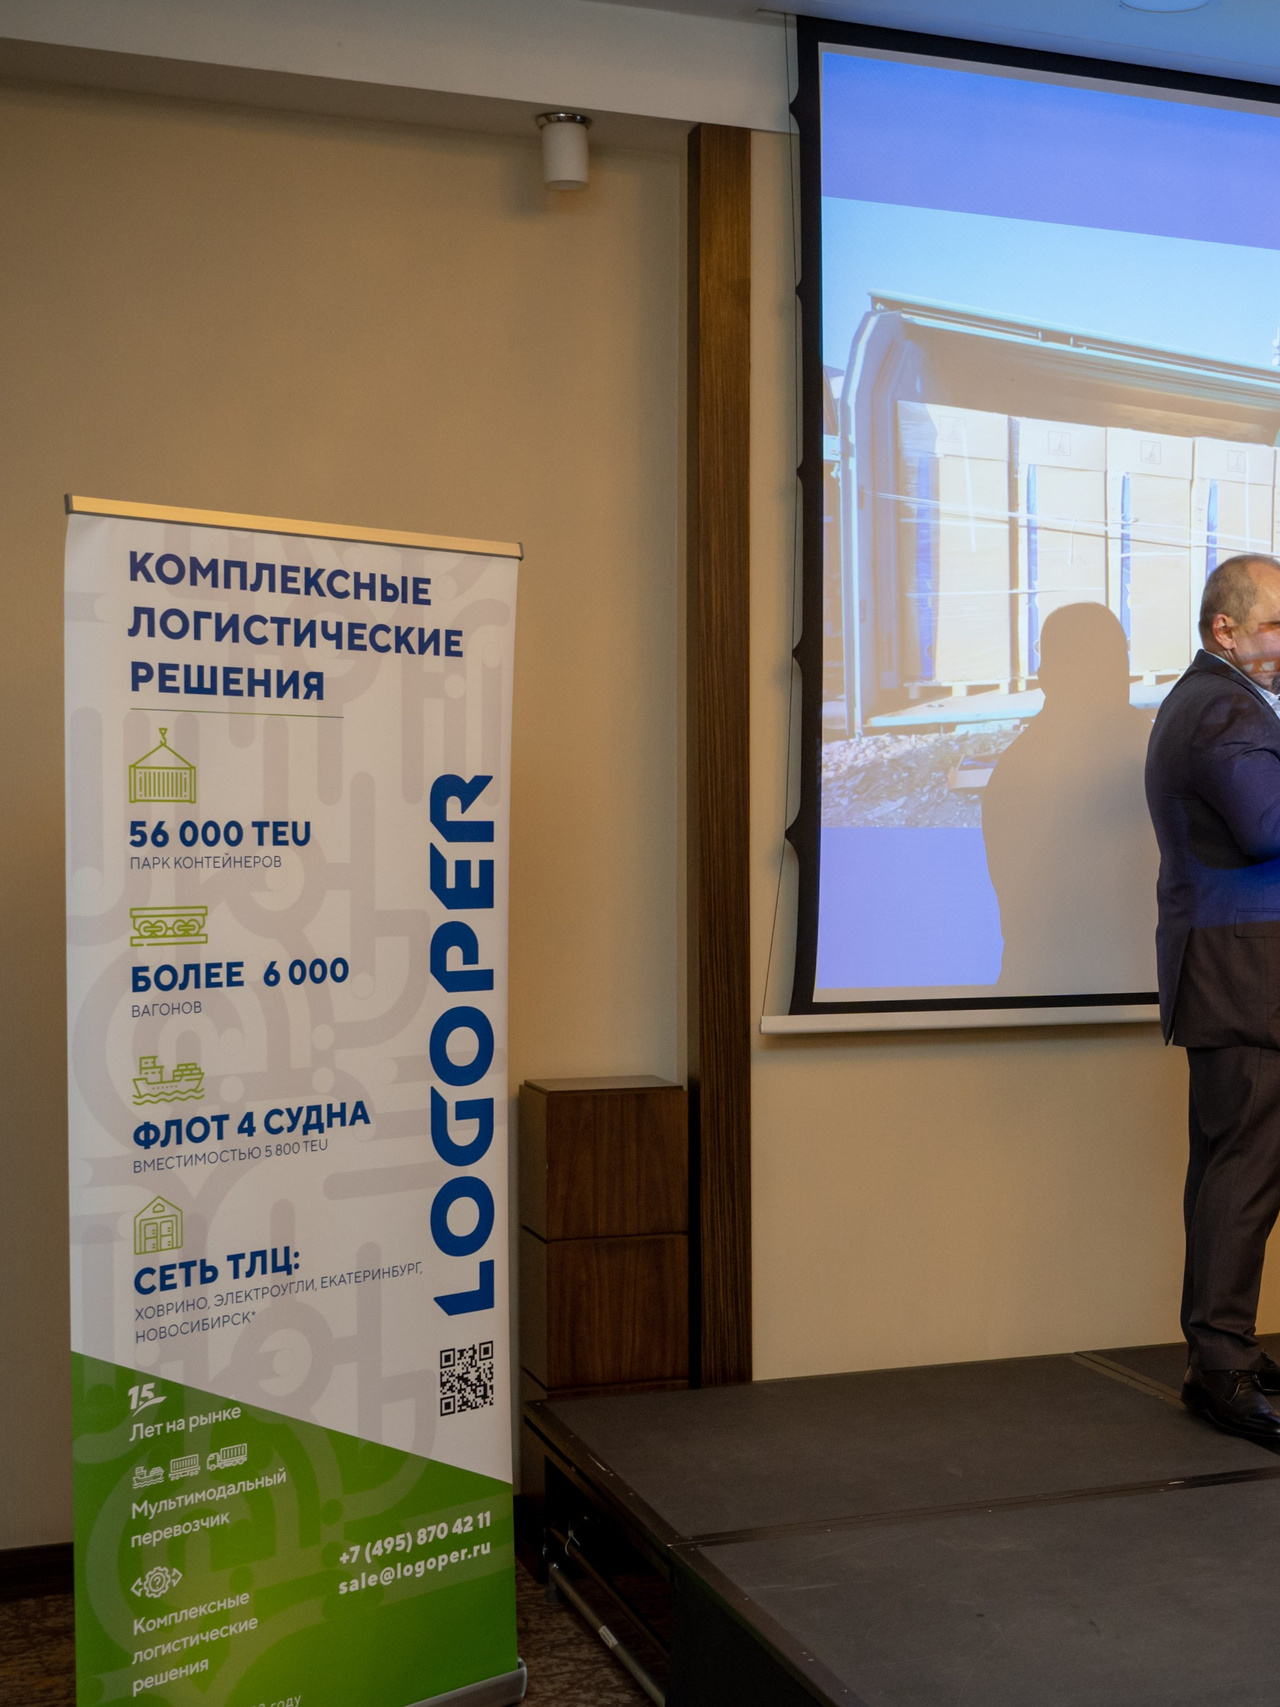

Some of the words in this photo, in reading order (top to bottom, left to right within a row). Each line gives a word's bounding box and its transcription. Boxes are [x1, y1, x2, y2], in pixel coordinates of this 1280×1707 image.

[129, 550, 432, 606] КОМПЛЕКСНЫЕ
[127, 606, 463, 658] ЛОГИСТИЧЕСКИЕ
[130, 661, 324, 700] РЕШЕНИЯ
[129, 819, 170, 848] 56
[179, 819, 244, 848] 000
[251, 820, 311, 847] TEU
[130, 856, 171, 870] ПАРК
[173, 853, 282, 869] КОНТЕЙНЕРОВ
[131, 961, 245, 993] БОЛЕЕ
[262, 960, 281, 988] 6
[288, 957, 350, 985] 000
[131, 1001, 203, 1018] ВАГОНОВ
[429, 773, 495, 1316] LOGOPER
[133, 1112, 230, 1150] ФЛОТ
[237, 1110, 257, 1138] 4
[263, 1100, 371, 1137] СУДНА
[133, 1146, 262, 1174] ВМЕСТИМОСТЬЮ
[264, 1144, 273, 1159] 5
[274, 1142, 301, 1157] 800
[302, 1138, 329, 1154] TEU
[133, 1260, 219, 1296] СЕТЬ
[227, 1245, 300, 1281] ТЛЦ:
[135, 1294, 212, 1321] ХОВРИНО,
[213, 1278, 318, 1307] ЭЛЕКТРОУГЛИ,
[320, 1261, 423, 1289] ЕКАТЕРИНБУРГ,
[128, 1382, 156, 1411] 15
[129, 1423, 163, 1442] Лет
[166, 1417, 186, 1434] на
[189, 1406, 242, 1432] рынке
[131, 1467, 287, 1520] Мультимодальный
[131, 1512, 230, 1548] перевозчик
[339, 1546, 360, 1566] +7
[365, 1532, 413, 1564] (495)
[416, 1522, 448, 1547] 870
[451, 1515, 475, 1537] 42
[477, 1510, 492, 1529] 11
[339, 1540, 492, 1595] sale@logoper.ru
[133, 1592, 250, 1636] Комплексные
[132, 1616, 258, 1665] логистические
[132, 1658, 209, 1697] решения
